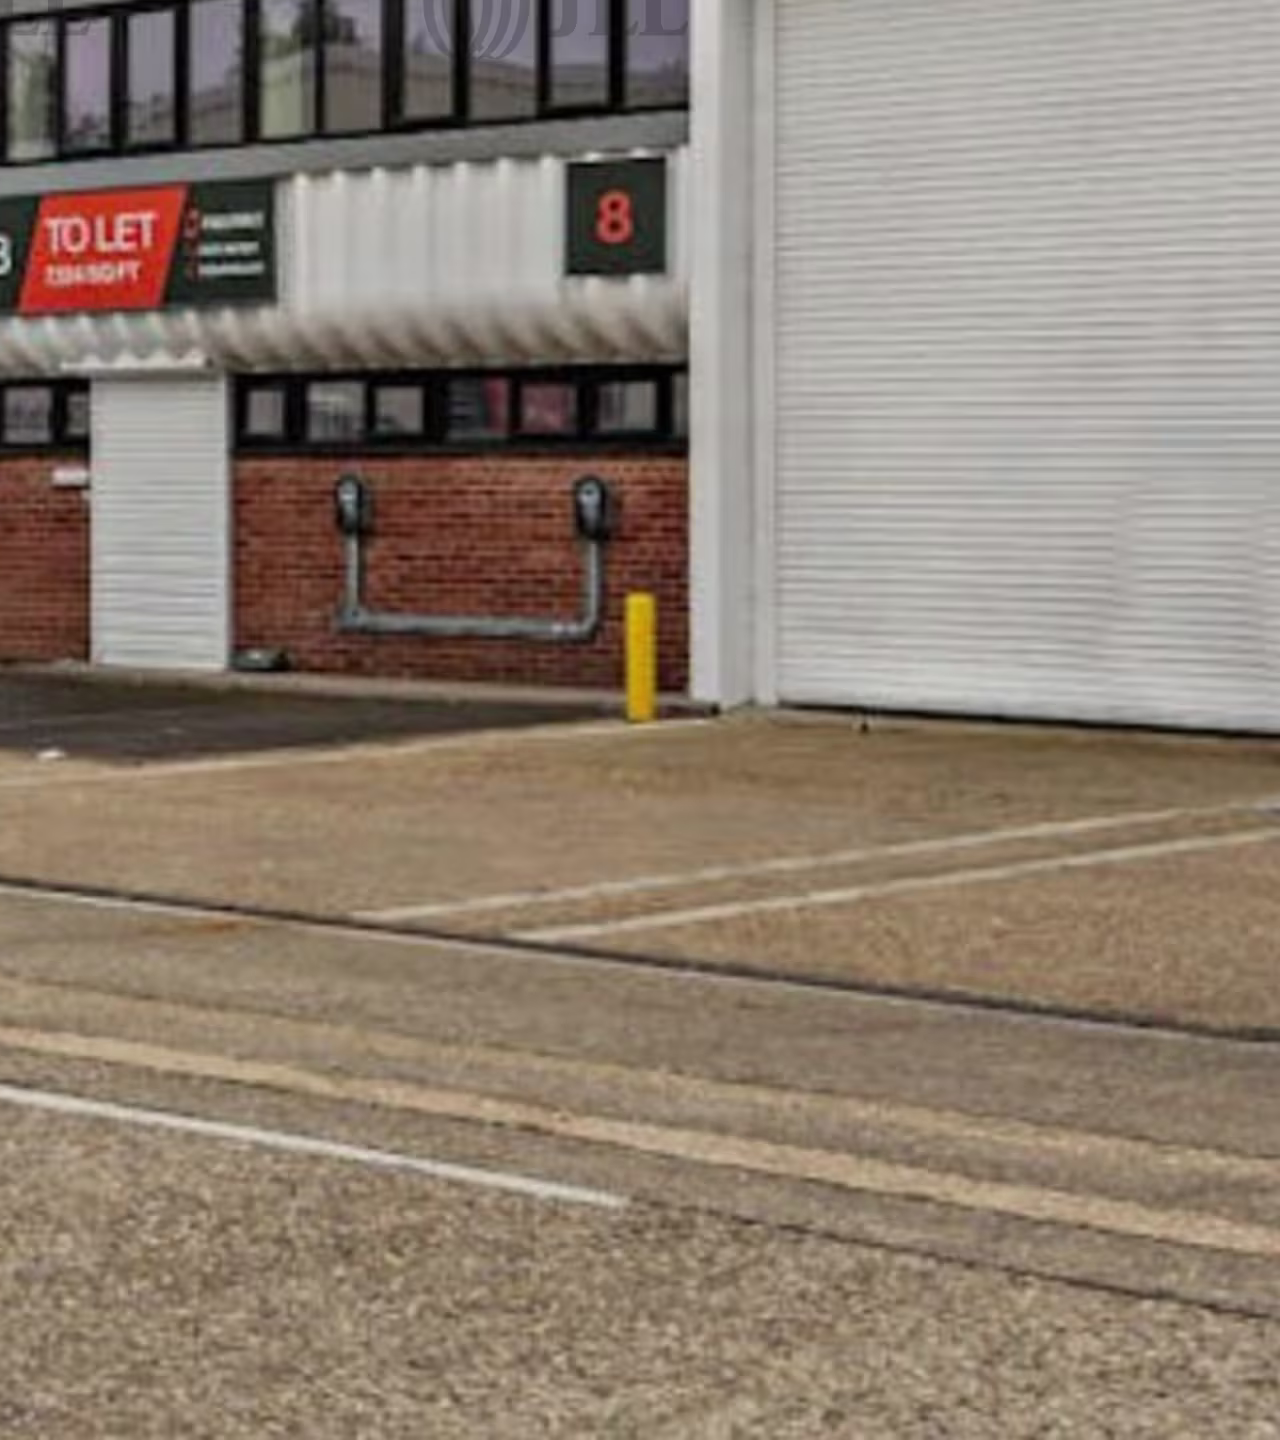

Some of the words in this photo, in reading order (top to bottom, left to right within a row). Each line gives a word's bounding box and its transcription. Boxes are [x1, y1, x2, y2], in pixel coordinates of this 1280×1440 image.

[44, 216, 90, 257] TO
[95, 212, 158, 254] LET
[597, 191, 632, 244] 8
